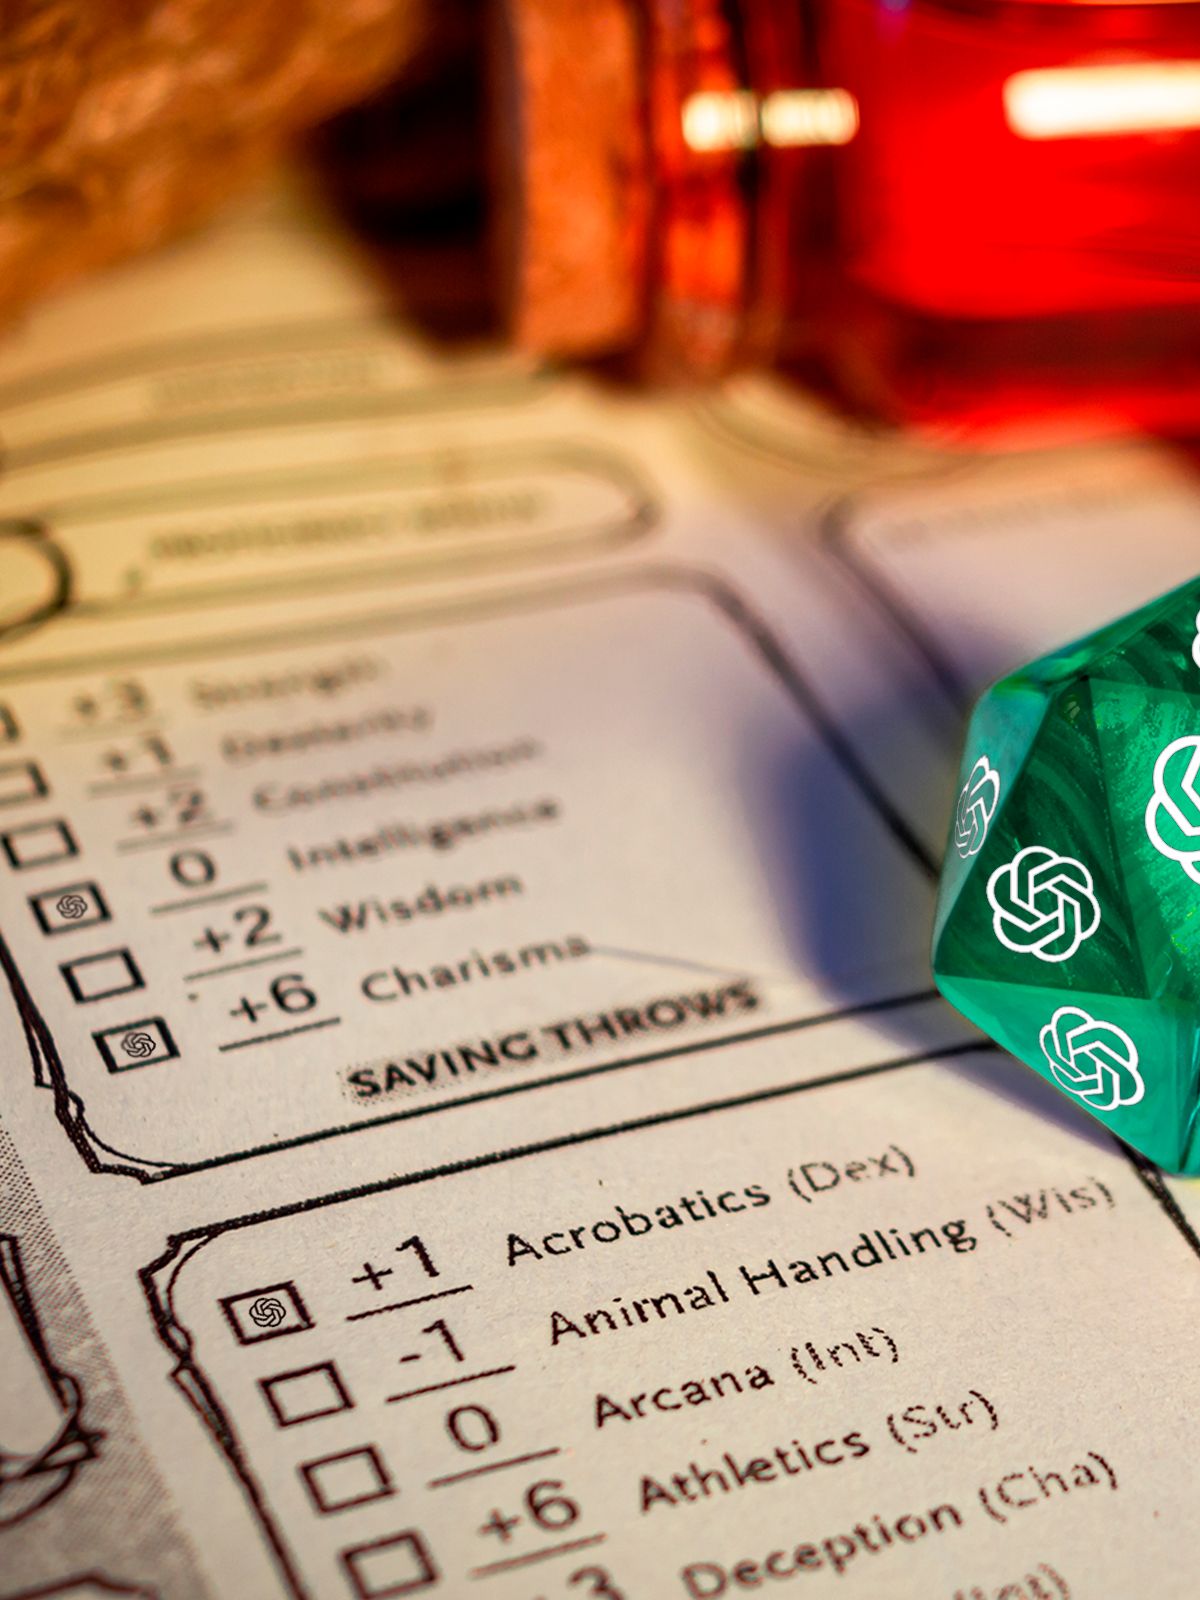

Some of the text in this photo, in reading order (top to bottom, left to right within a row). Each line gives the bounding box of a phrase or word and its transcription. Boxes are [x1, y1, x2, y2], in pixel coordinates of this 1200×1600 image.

[170, 851, 216, 887] 0
[194, 874, 522, 954] +2 Wisdom
[229, 935, 590, 1024] +6 Charisma
[349, 982, 761, 1100] SAVING THROWS
[352, 1144, 917, 1290] +1 Acrobatics (Dex)
[399, 1175, 1117, 1362] -1 Animal Handling (Wis)
[446, 1326, 900, 1452] 0 Arcana (Int)
[479, 1390, 1000, 1542] +6 Athletics (Str)
[681, 1503, 964, 1600] Deception
[978, 1452, 1119, 1524] (Cha)
